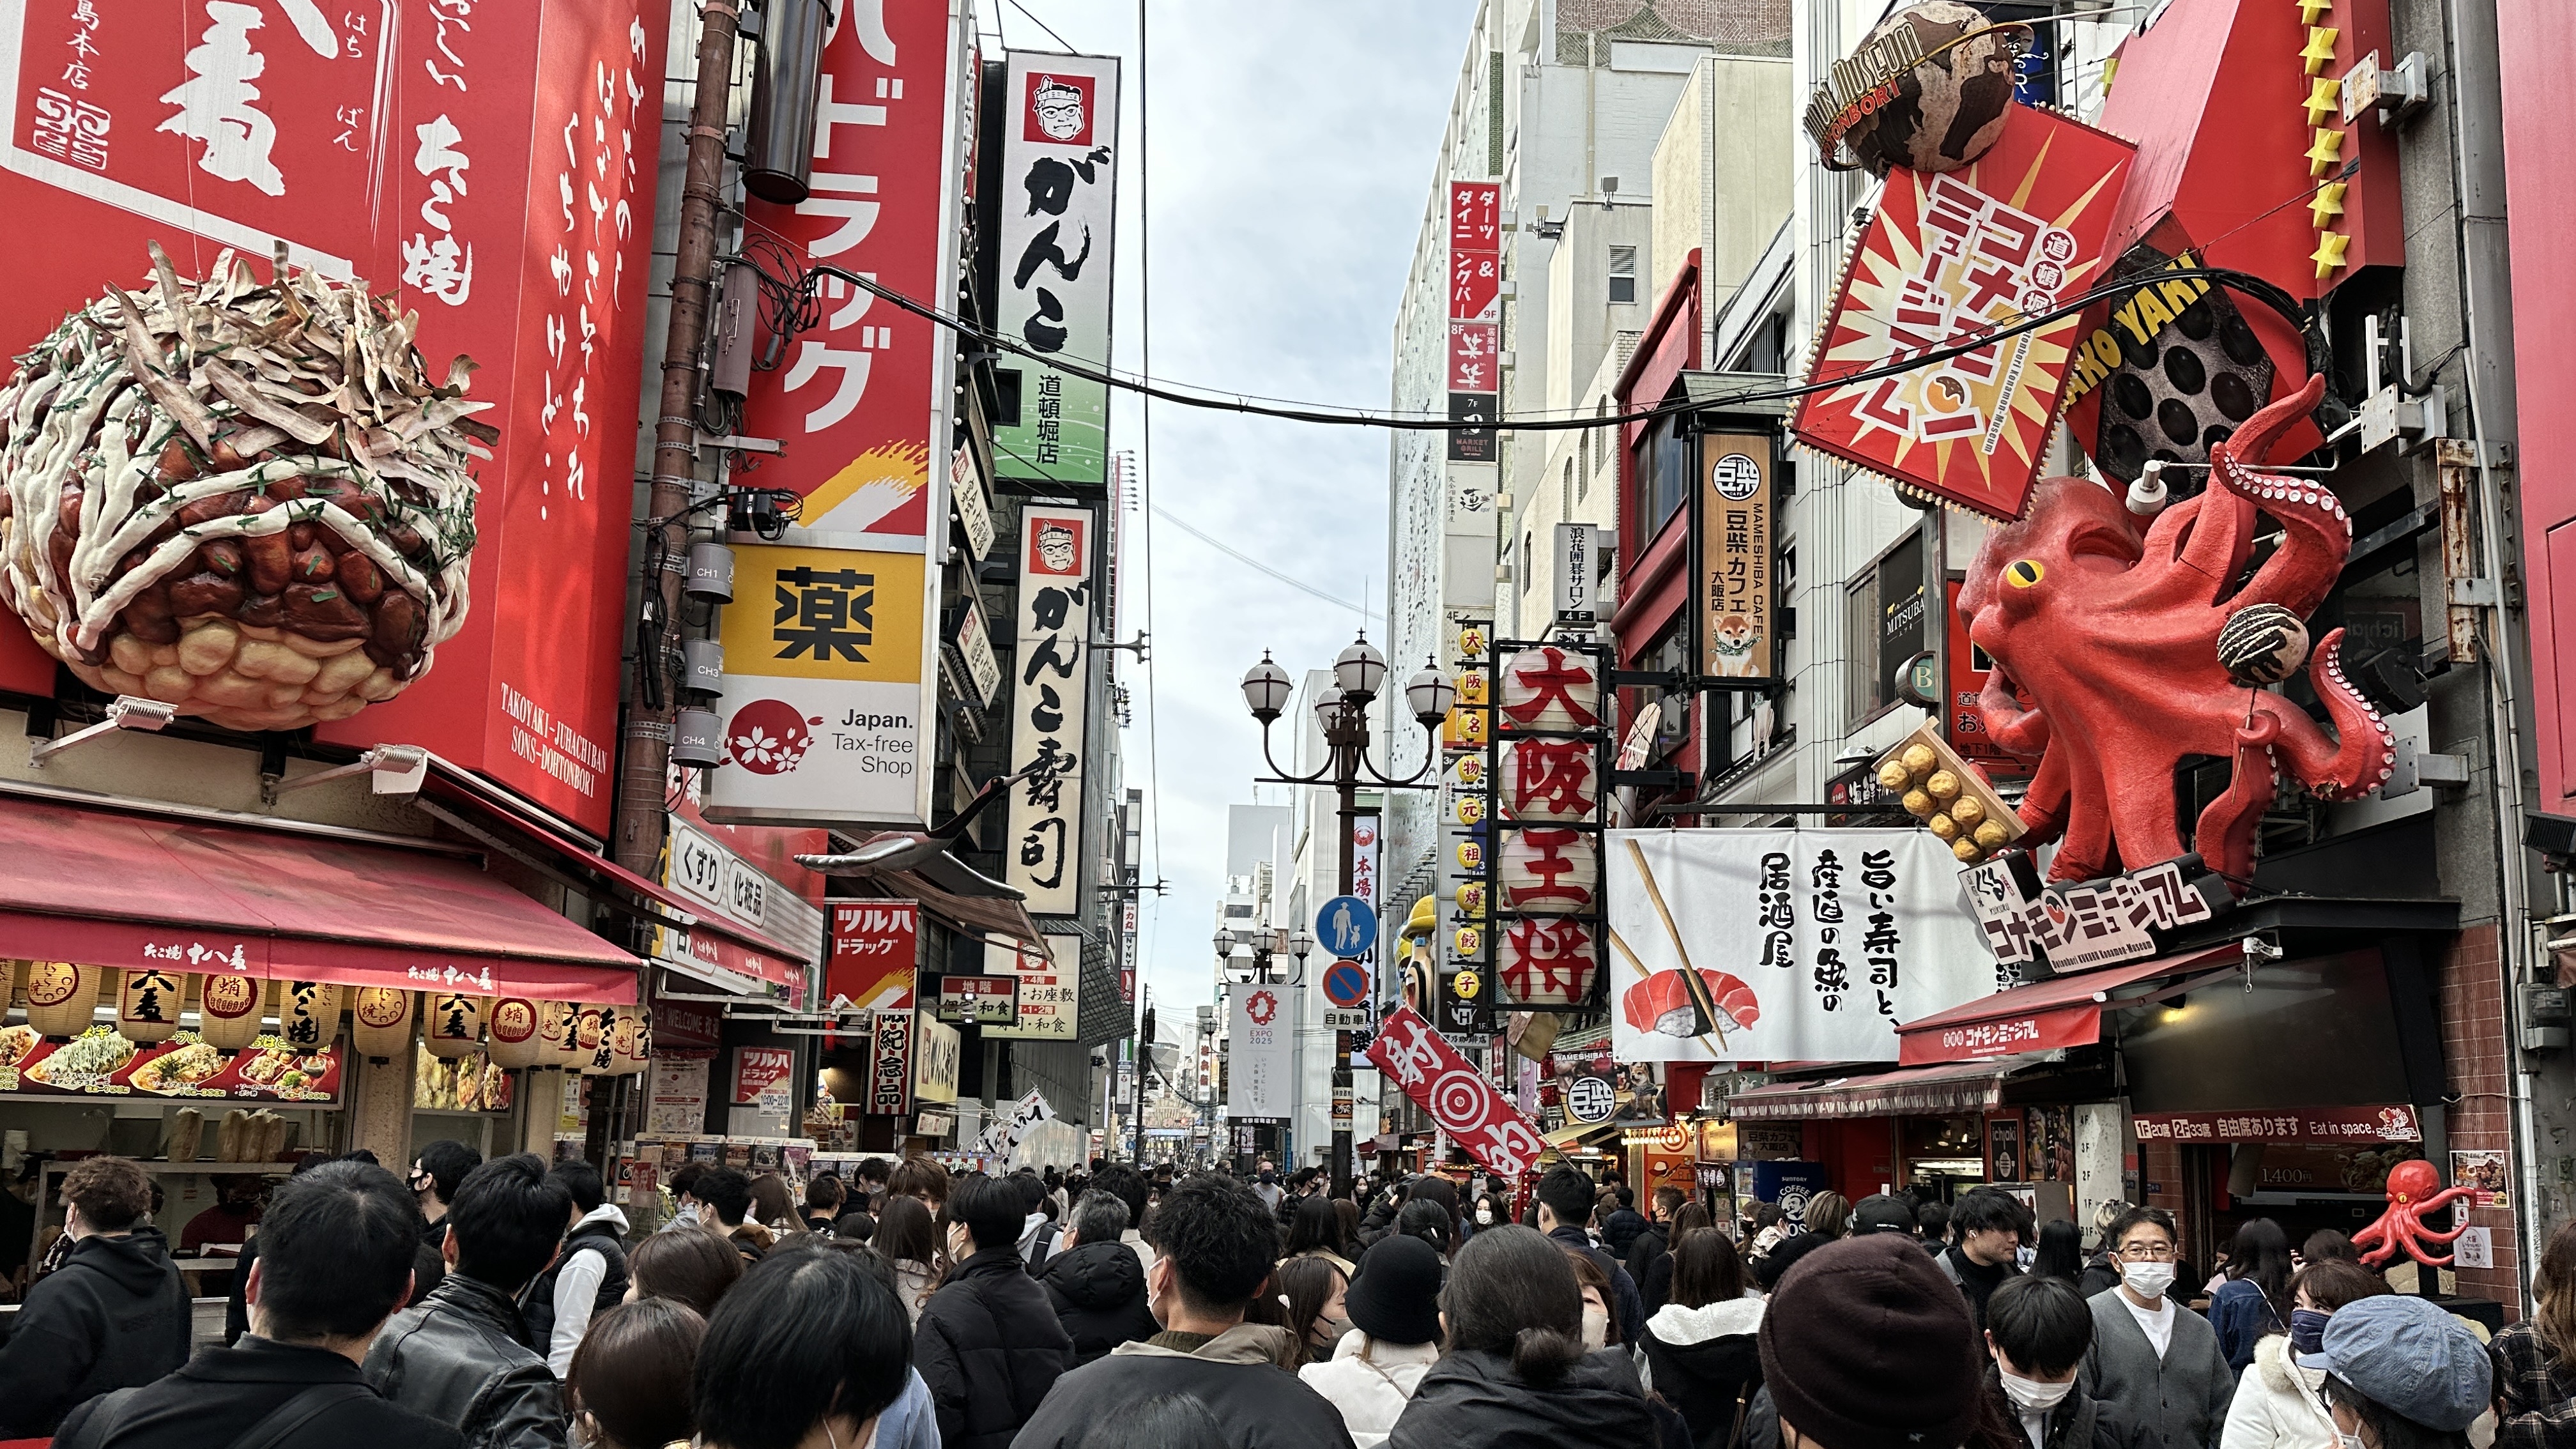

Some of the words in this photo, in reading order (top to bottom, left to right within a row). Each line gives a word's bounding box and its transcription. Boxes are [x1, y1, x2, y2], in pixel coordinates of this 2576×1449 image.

[344, 11, 367, 59] はち
[333, 104, 366, 153] ばん
[402, 114, 471, 306] たこ焼
[1479, 190, 1496, 240] ダーツ
[1014, 145, 1112, 353] がんこ
[1478, 261, 1494, 278] &
[2023, 231, 2073, 319] 道頓堀
[2114, 249, 2212, 346] YAKI
[1483, 309, 1497, 319] 9F
[1450, 325, 1464, 335] 8F
[2014, 329, 2034, 368] otonbori
[1467, 399, 1478, 408] 7F
[1036, 375, 1062, 466] 道頓堀店
[1753, 503, 1763, 589] MAMESHIBA
[696, 567, 717, 578] CH1
[1568, 526, 1585, 610] 浪花囲碁サロン
[1726, 510, 1747, 613] 豆柴カフェ
[1712, 571, 1724, 611] 大阪店
[774, 566, 874, 663] 薬
[1446, 611, 1459, 620] 4F
[1753, 595, 1763, 634] CAFE
[1886, 597, 1924, 636] MITSUBA
[698, 665, 719, 677] CH3
[1914, 666, 1933, 688] B
[841, 709, 914, 731] Japan.
[1958, 712, 1986, 733] お
[682, 735, 705, 746] CH4
[832, 733, 913, 755] Tax-free
[1958, 742, 2001, 756] 地下1階
[511, 724, 595, 799] SONS-DOHTONBORI
[861, 755, 912, 779] Shop
[1443, 756, 1455, 766] 3F
[1499, 647, 1607, 1003] 大阪王将
[684, 841, 717, 892] くすり
[1353, 854, 1372, 904] 本場
[734, 871, 762, 917] 化粧品
[838, 910, 913, 933] ツルハ
[1124, 912, 1134, 930] 力丸
[1758, 852, 1795, 969] 居酒屋
[1984, 869, 2207, 959] コナモンミュージアム
[1811, 848, 1849, 1011] 産直の魚の
[144, 943, 182, 960] たこ焼
[836, 939, 898, 956] ドラッグ
[2051, 955, 2077, 969] Dotonbori
[2078, 951, 2100, 964] KUKURU
[962, 980, 992, 993] 地階
[1020, 987, 1075, 1002] ・お座敷
[978, 1000, 1011, 1016] 和食
[1018, 1006, 1054, 1015] ・1・2階
[663, 1005, 703, 1034] WELCOME
[1326, 1013, 1364, 1026] 自動車
[1966, 1020, 2039, 1046] コナモンミュージアム
[744, 1051, 789, 1068] ツルハ
[1555, 1053, 1606, 1062] MAMESHIBA
[742, 1068, 779, 1079] ドラッグ
[1748, 1131, 1796, 1142] 豆柴カフェ
[2217, 1116, 2299, 1138] 自由席あります
[2310, 1121, 2327, 1135] Eat
[2329, 1121, 2339, 1135] in
[2341, 1121, 2375, 1137] space.
[2082, 1142, 2090, 1153] 3F
[2083, 1170, 2090, 1181] 2F
[2262, 1167, 2313, 1184] 1,400円
[1779, 1184, 1811, 1197] COFFEE
[2084, 1199, 2092, 1209] 1F
[1788, 1223, 1807, 1237] OS
